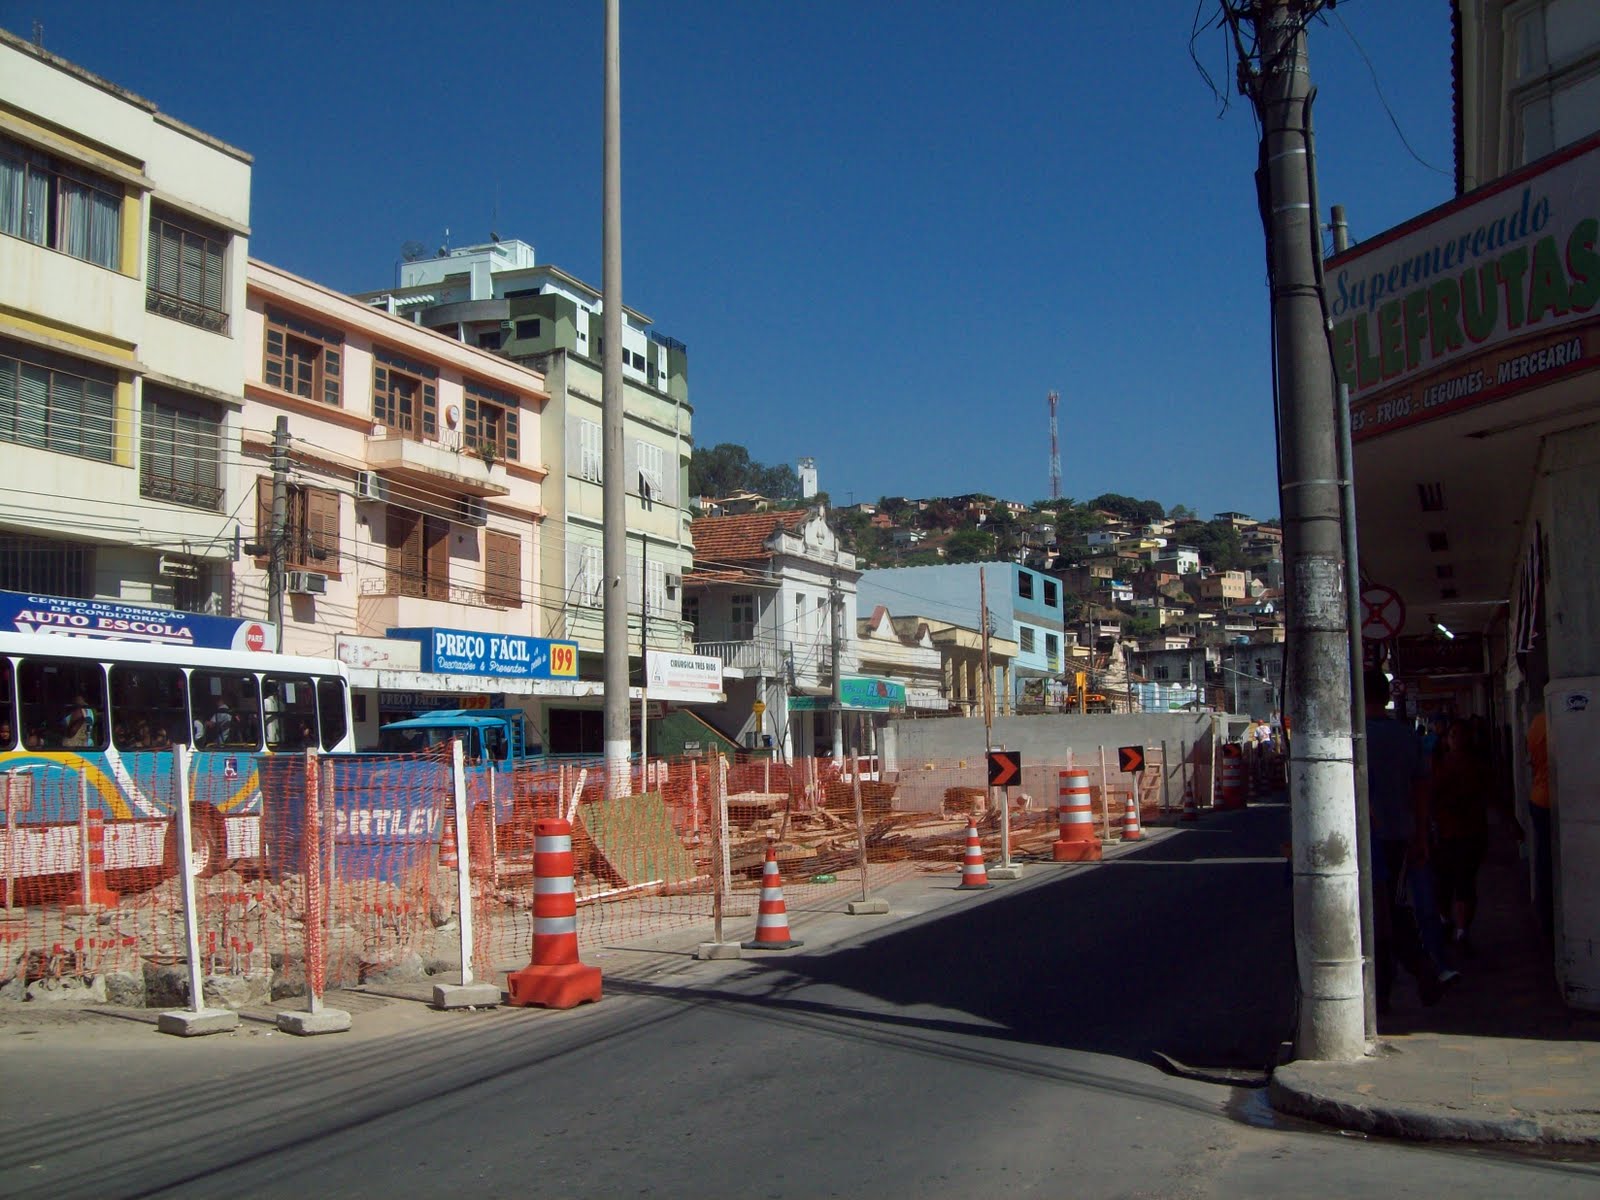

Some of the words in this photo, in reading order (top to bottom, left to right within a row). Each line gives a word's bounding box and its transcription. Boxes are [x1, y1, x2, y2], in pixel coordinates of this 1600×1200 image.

[1332, 188, 1552, 316] Supermercado
[1376, 396, 1412, 424] FRIOS
[1424, 371, 1484, 407] LEGUMES
[1497, 337, 1583, 383] MERCEARIA
[27, 596, 87, 608] CENTRO
[92, 603, 111, 611] DE
[115, 606, 186, 620] FORMAÇÃO
[51, 605, 71, 613] DE
[76, 608, 166, 623] CONDUTORES
[15, 610, 90, 626] AUTO
[97, 618, 193, 637] ESCOLA
[248, 634, 263, 642] PARE
[435, 633, 485, 661] PREÇO
[490, 635, 530, 662] FÁCIL
[438, 657, 476, 671] Decorações
[489, 661, 528, 674] Presentes
[706, 662, 717, 671] RIOS
